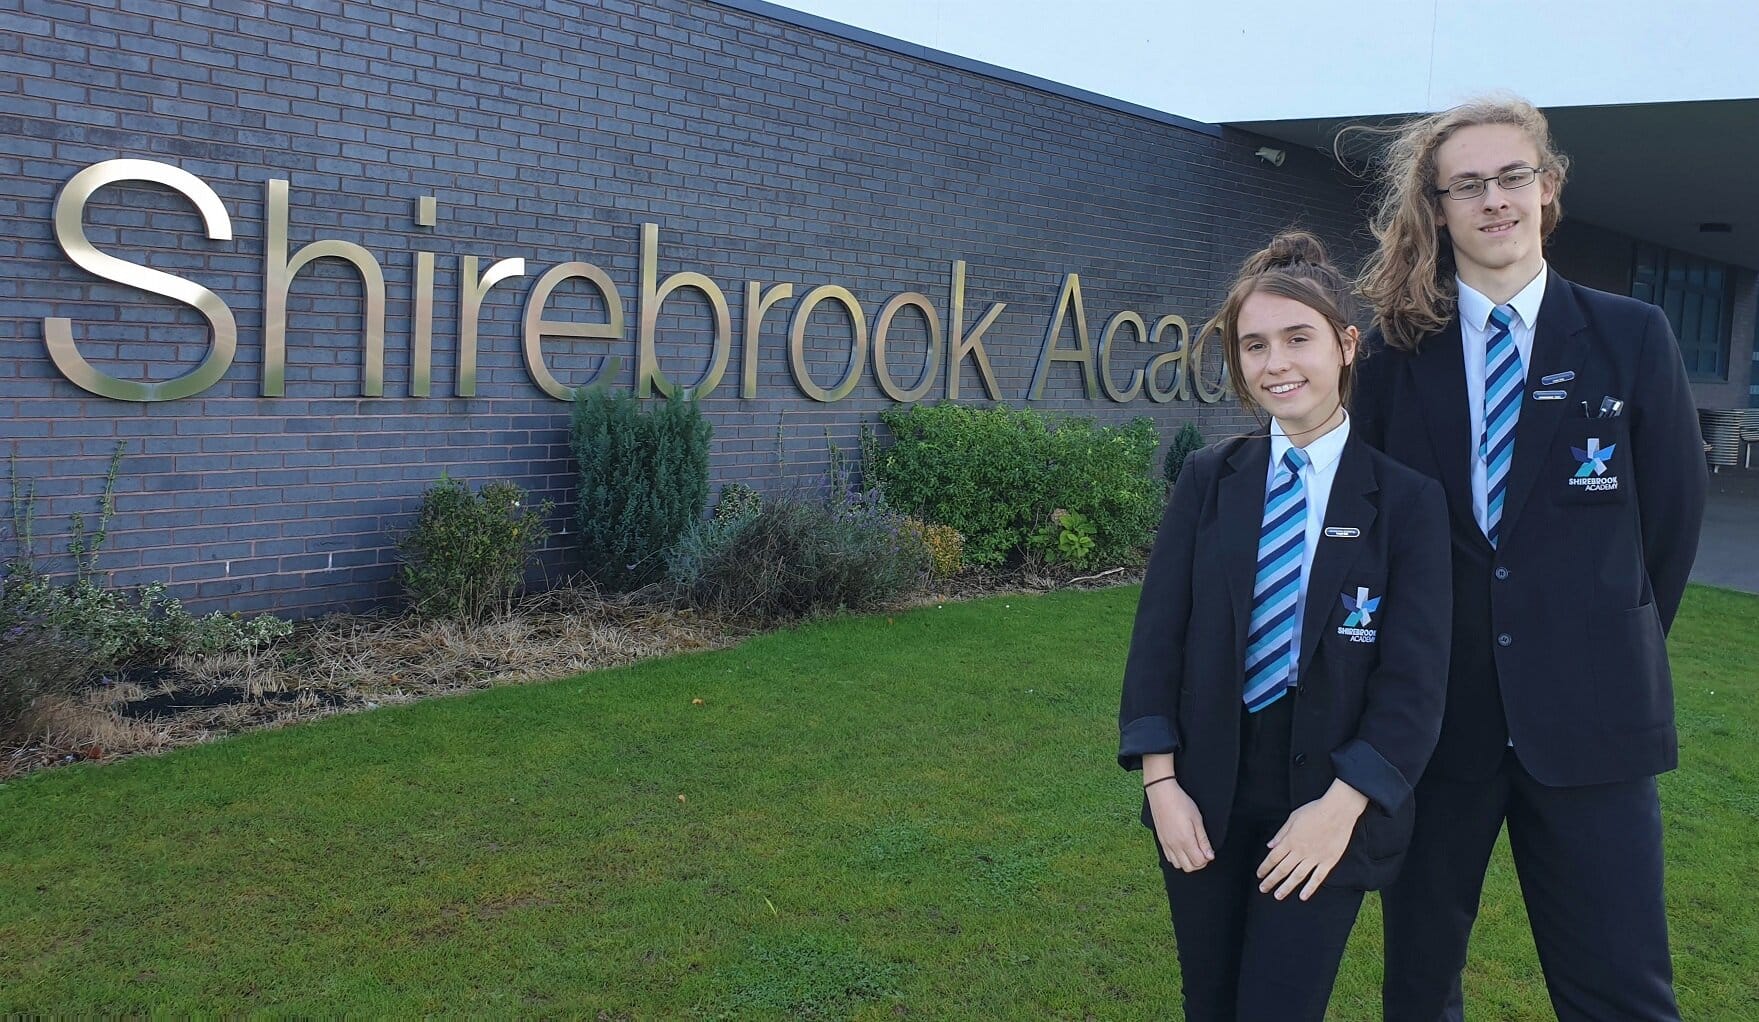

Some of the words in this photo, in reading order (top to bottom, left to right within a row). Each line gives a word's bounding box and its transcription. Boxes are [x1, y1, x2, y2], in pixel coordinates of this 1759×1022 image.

[42, 158, 1006, 402] Shirebrook
[1568, 476, 1618, 486] SHIREBROOK
[1584, 482, 1618, 492] ACADEMY
